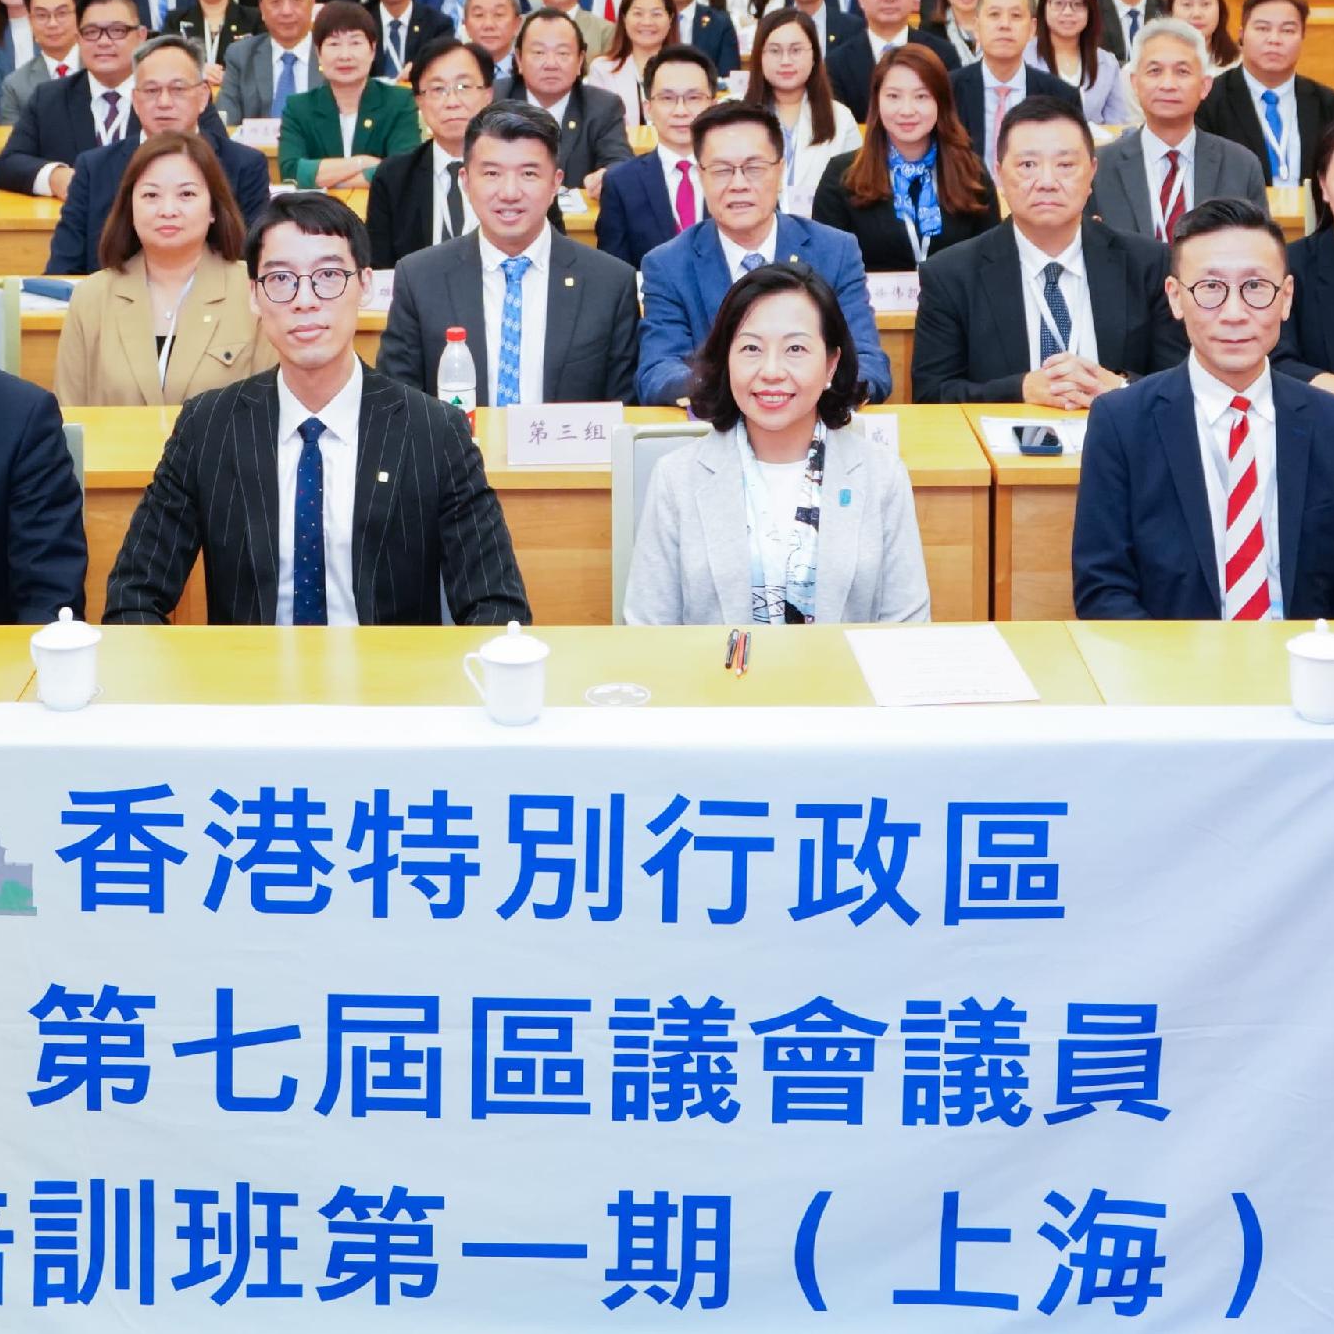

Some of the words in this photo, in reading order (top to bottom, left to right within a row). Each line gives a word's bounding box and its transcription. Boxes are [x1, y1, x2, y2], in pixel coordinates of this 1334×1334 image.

[527, 420, 607, 446] 第三组
[56, 783, 1069, 927] 香港特別行政區
[27, 983, 1171, 1128] 第七屆區議會議員
